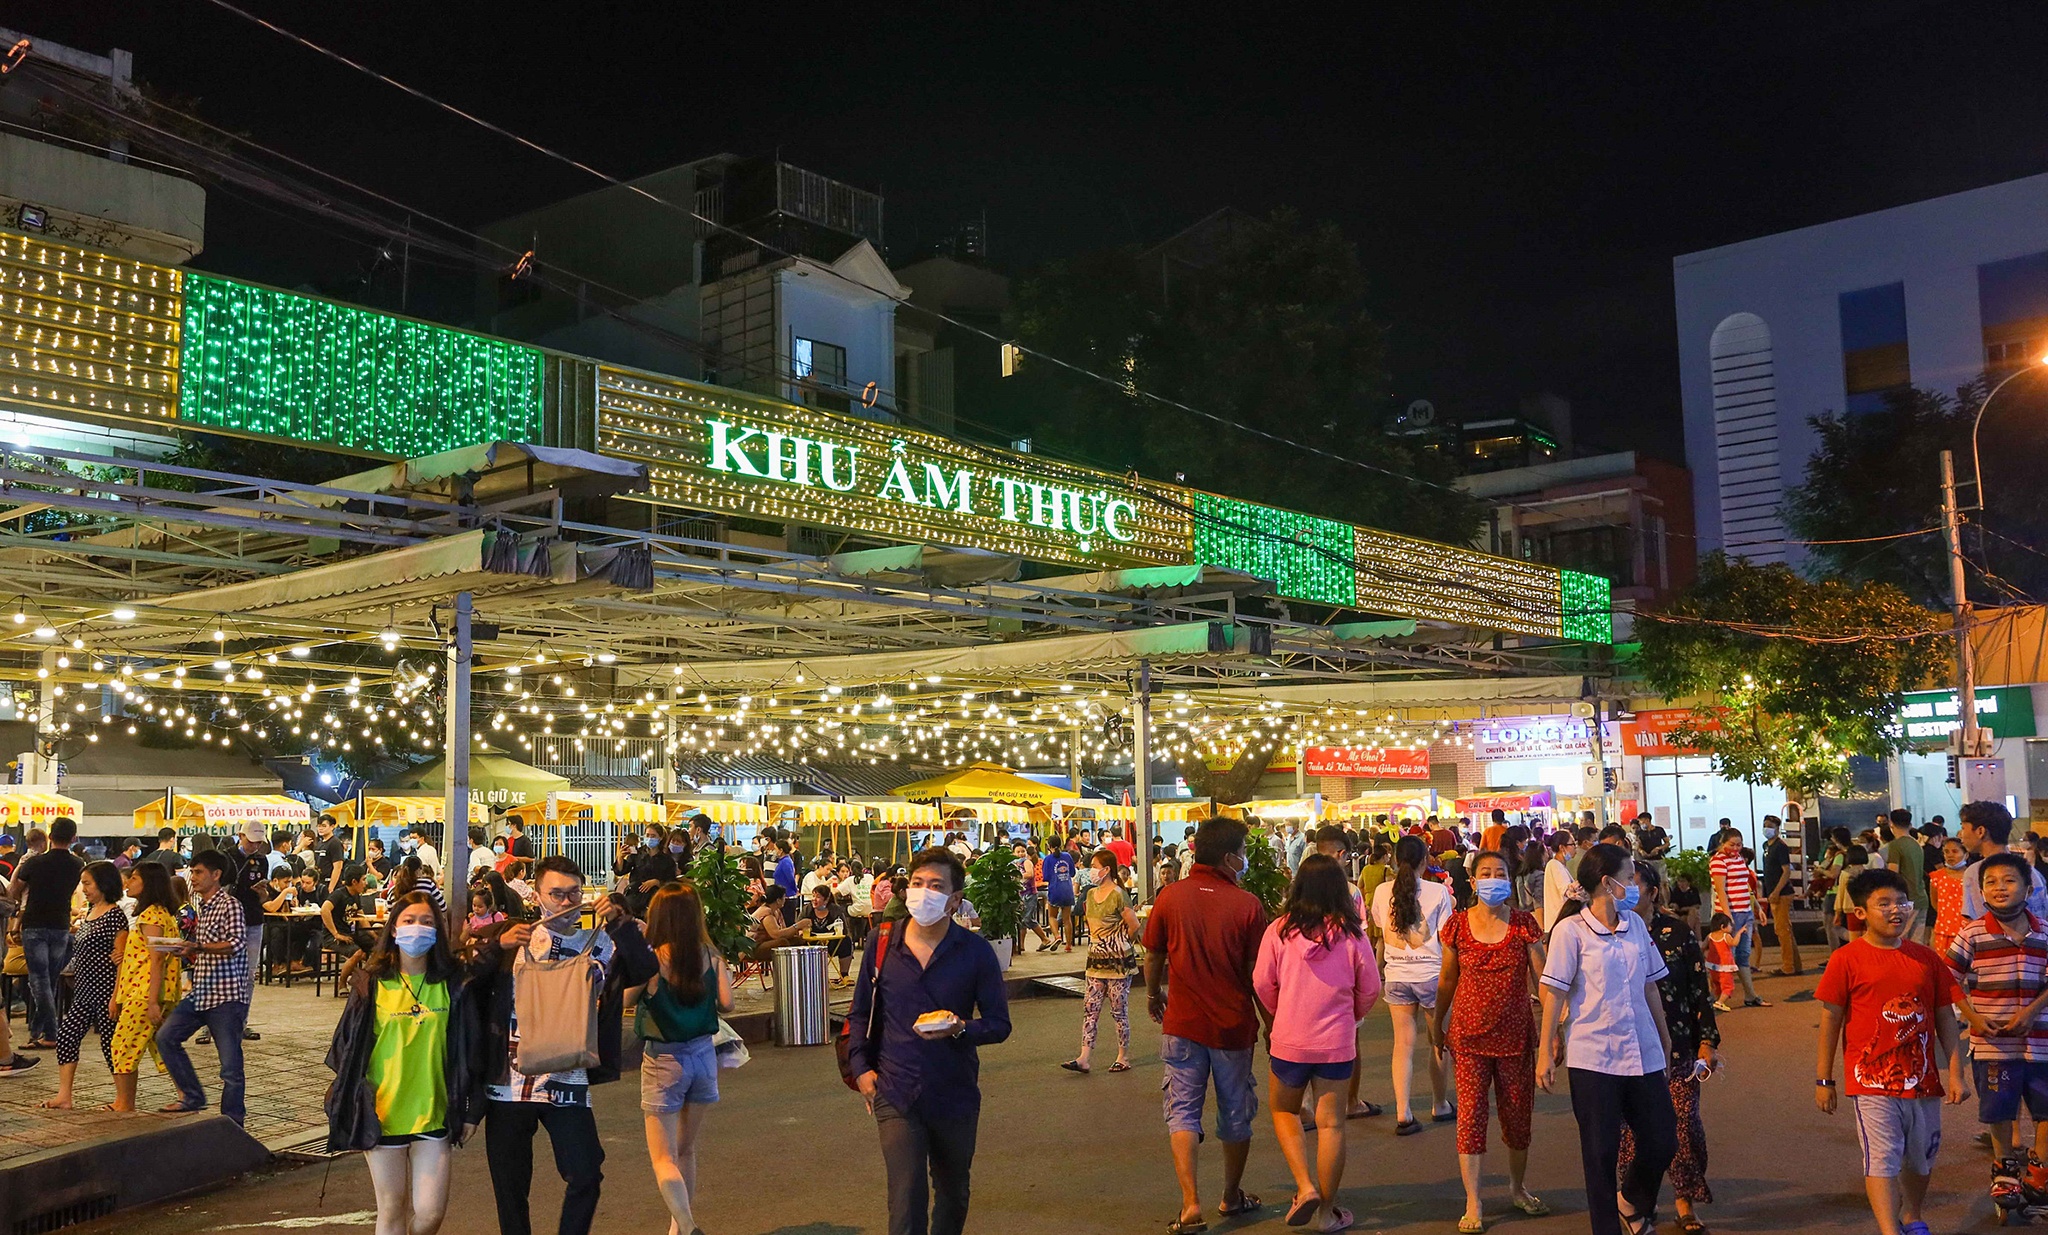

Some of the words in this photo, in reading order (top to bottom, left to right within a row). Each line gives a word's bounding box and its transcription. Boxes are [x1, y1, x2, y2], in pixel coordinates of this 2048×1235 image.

[704, 418, 860, 492] KHU
[877, 437, 976, 515] ẨM
[991, 475, 1137, 553] THỰC
[1482, 725, 1561, 744] LONG
[1634, 729, 1660, 748] VĂN
[1380, 752, 1386, 762] 2
[1413, 765, 1428, 774] 20%
[467, 788, 484, 804] BÃI
[487, 788, 508, 803] GIỮ
[511, 791, 527, 804] XE
[21, 806, 75, 816] LINHNA
[263, 806, 285, 817] THÁI
[288, 808, 307, 818] LAN
